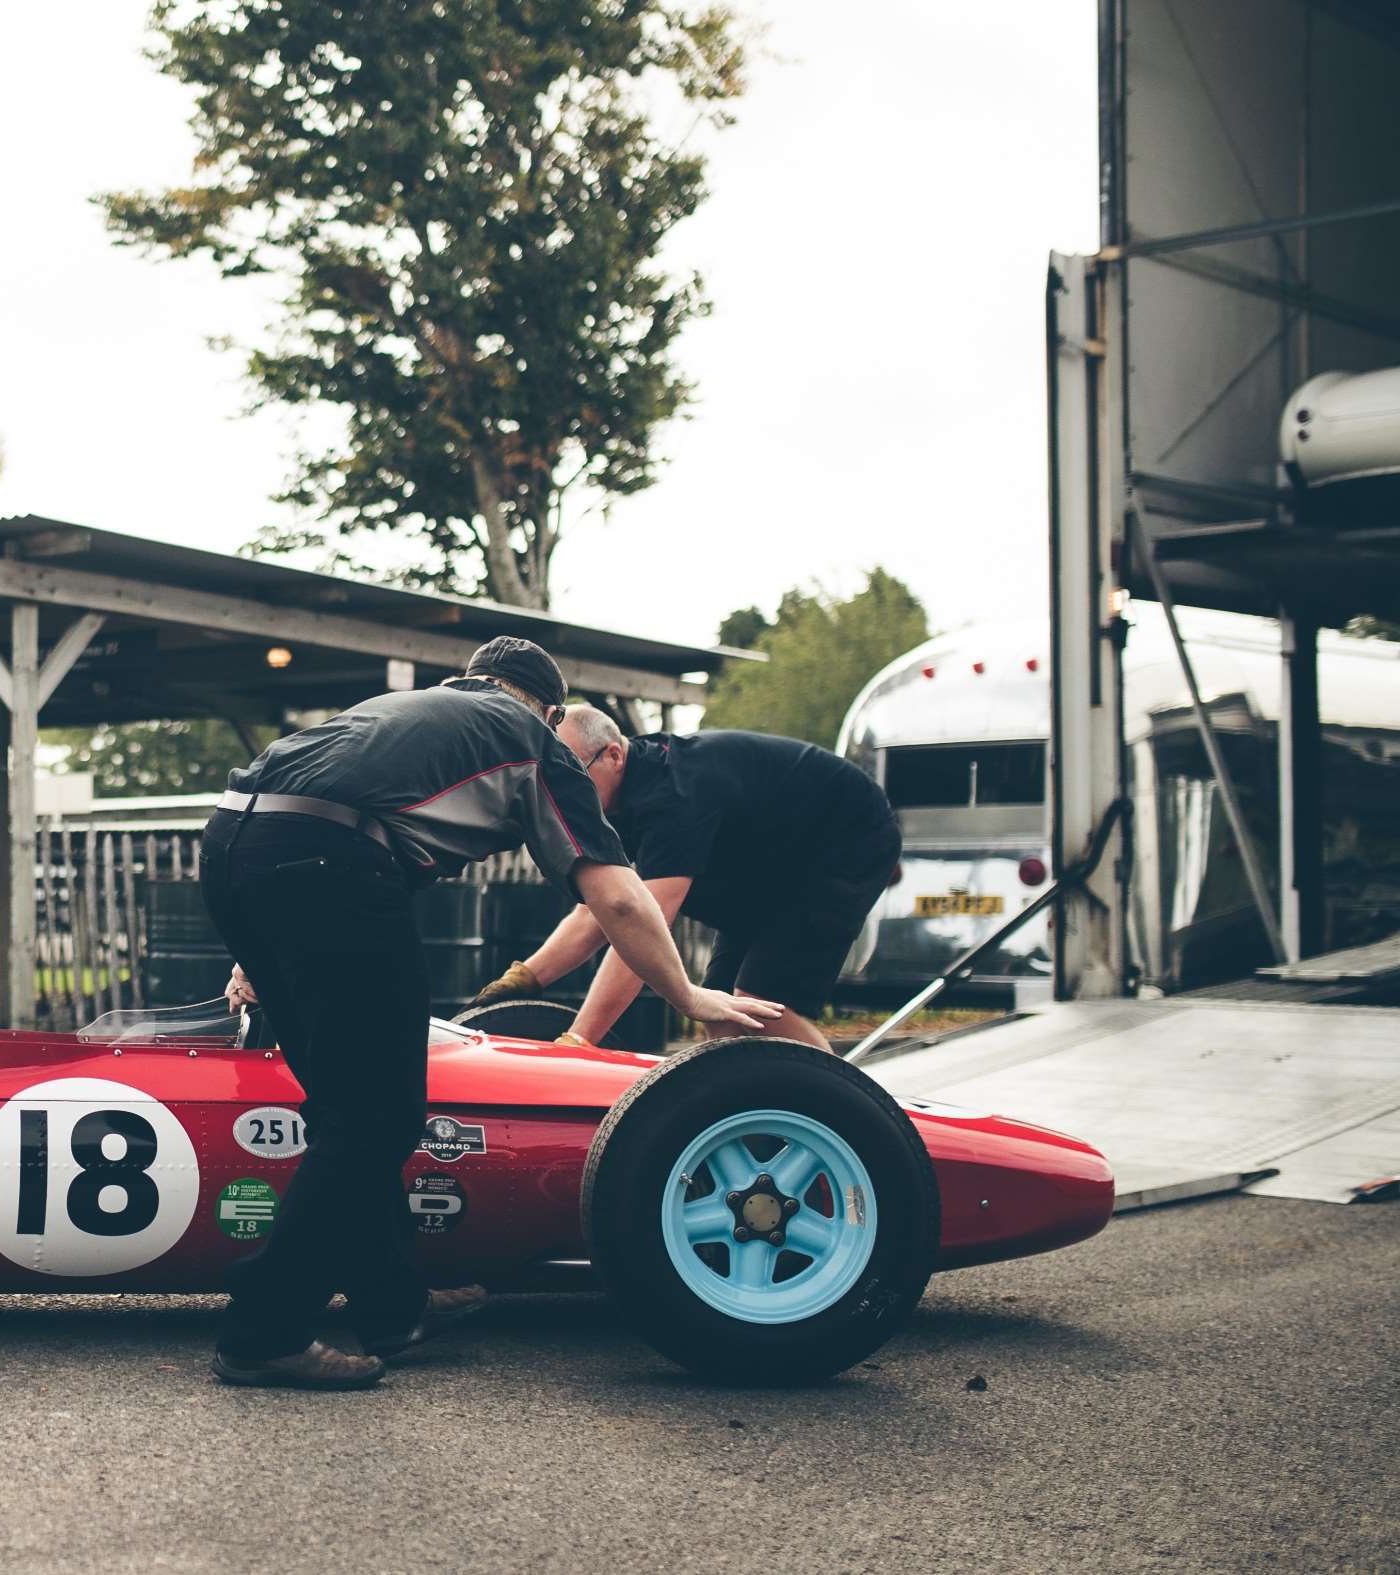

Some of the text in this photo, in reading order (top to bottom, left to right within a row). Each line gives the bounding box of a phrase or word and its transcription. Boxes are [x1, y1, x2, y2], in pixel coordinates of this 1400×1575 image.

[249, 1119, 299, 1145] 251
[421, 1142, 471, 1151] CHOPARD
[16, 1109, 160, 1236] 18
[237, 1220, 257, 1232] 18
[424, 1215, 444, 1226] 12
